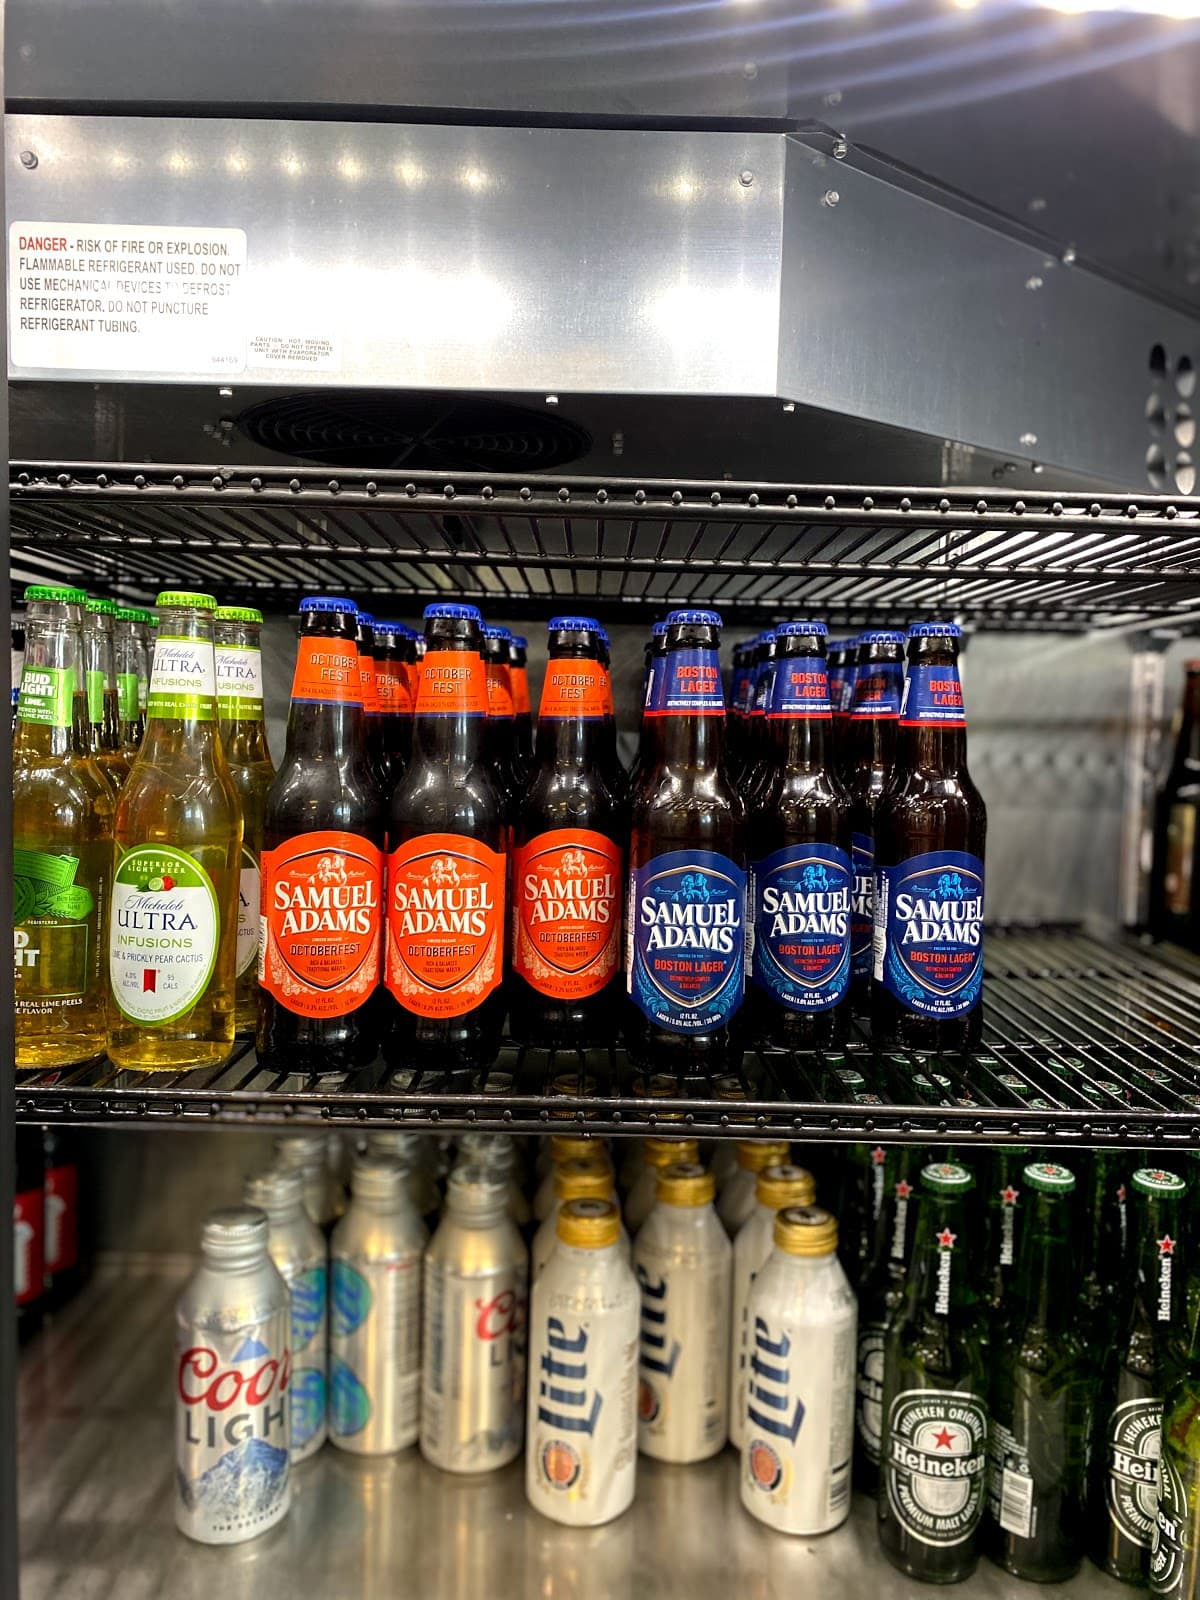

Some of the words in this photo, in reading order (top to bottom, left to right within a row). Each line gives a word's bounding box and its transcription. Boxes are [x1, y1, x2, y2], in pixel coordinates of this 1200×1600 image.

[19, 236, 67, 251] DANGER
[77, 239, 101, 253] RISK
[104, 240, 118, 253] OF
[121, 240, 145, 254] FIRE
[148, 241, 163, 254] OR
[167, 242, 229, 256] EXPLOSION.
[20, 257, 85, 272] FLAMMABLE
[89, 259, 161, 274] REFRIGERANT
[202, 263, 216, 276] DO
[220, 264, 240, 276] NOT
[20, 277, 41, 290] USE
[20, 297, 105, 313] REFRIGERATOR.
[108, 300, 122, 313] DO
[126, 301, 148, 313] NOT
[152, 301, 209, 315] PUNCTURE
[20, 316, 95, 332] REFRIGERANT
[98, 319, 140, 334] TUBING.
[158, 647, 194, 660] Michelob
[24, 672, 51, 685] BUD
[217, 665, 254, 679] LTRA
[320, 668, 350, 682] FEST
[425, 667, 472, 680] OCTOBER
[676, 666, 718, 679] BOSTON
[432, 682, 462, 694] FEST
[552, 675, 595, 687] OCTOBER
[680, 680, 716, 693] LAGER
[929, 680, 962, 692] BOSTO
[20, 682, 56, 697] LIGHT
[377, 687, 395, 698] EST
[561, 688, 586, 699] FEST
[795, 686, 826, 697] LAGER
[131, 860, 180, 868] SUPERIOR
[524, 873, 616, 901] SAMUEL
[274, 880, 377, 910] SAMUEL
[394, 882, 494, 912] SAMUEL
[762, 886, 851, 914] SAMUEL
[124, 894, 184, 911] Michelob
[895, 893, 984, 921] SAMUEL
[530, 899, 609, 926] ADAMS
[640, 896, 740, 927] SAMUEL
[117, 909, 196, 931] ULTRA
[280, 908, 371, 938] ADAMS
[399, 911, 486, 938] ADAMS
[769, 911, 848, 937] ADAMS
[539, 931, 601, 943] OCTOBERFEST
[646, 924, 734, 953] ADAMS
[901, 919, 980, 946] ADAMS
[117, 935, 193, 949] INFUSIONS
[290, 943, 361, 957] OCTOBERFEST
[408, 944, 476, 958] OCTOBERFEST
[778, 944, 815, 956] BOSTON
[816, 944, 840, 955] LAGER
[910, 951, 947, 963] BOSTON
[949, 952, 973, 963] LAGER
[127, 952, 154, 963] PRICKLY
[155, 954, 174, 963] PEAR
[175, 954, 203, 964] CACTUS
[654, 959, 692, 972] BOSTON
[694, 960, 724, 973] LAGER
[162, 982, 178, 990] CALS
[61, 998, 83, 1006] PEELS
[22, 1007, 53, 1015] FLAVOR
[934, 1250, 951, 1315] Heineken
[1157, 1256, 1172, 1321] Heineken
[538, 1315, 603, 1438] Lite
[748, 1315, 806, 1448] Lite
[900, 1406, 945, 1437] HEINEKEN
[948, 1407, 983, 1442] ORIGINAL
[893, 1440, 985, 1477] Heineken
[898, 1483, 934, 1529] PREMIUM
[935, 1518, 961, 1530] MALT
